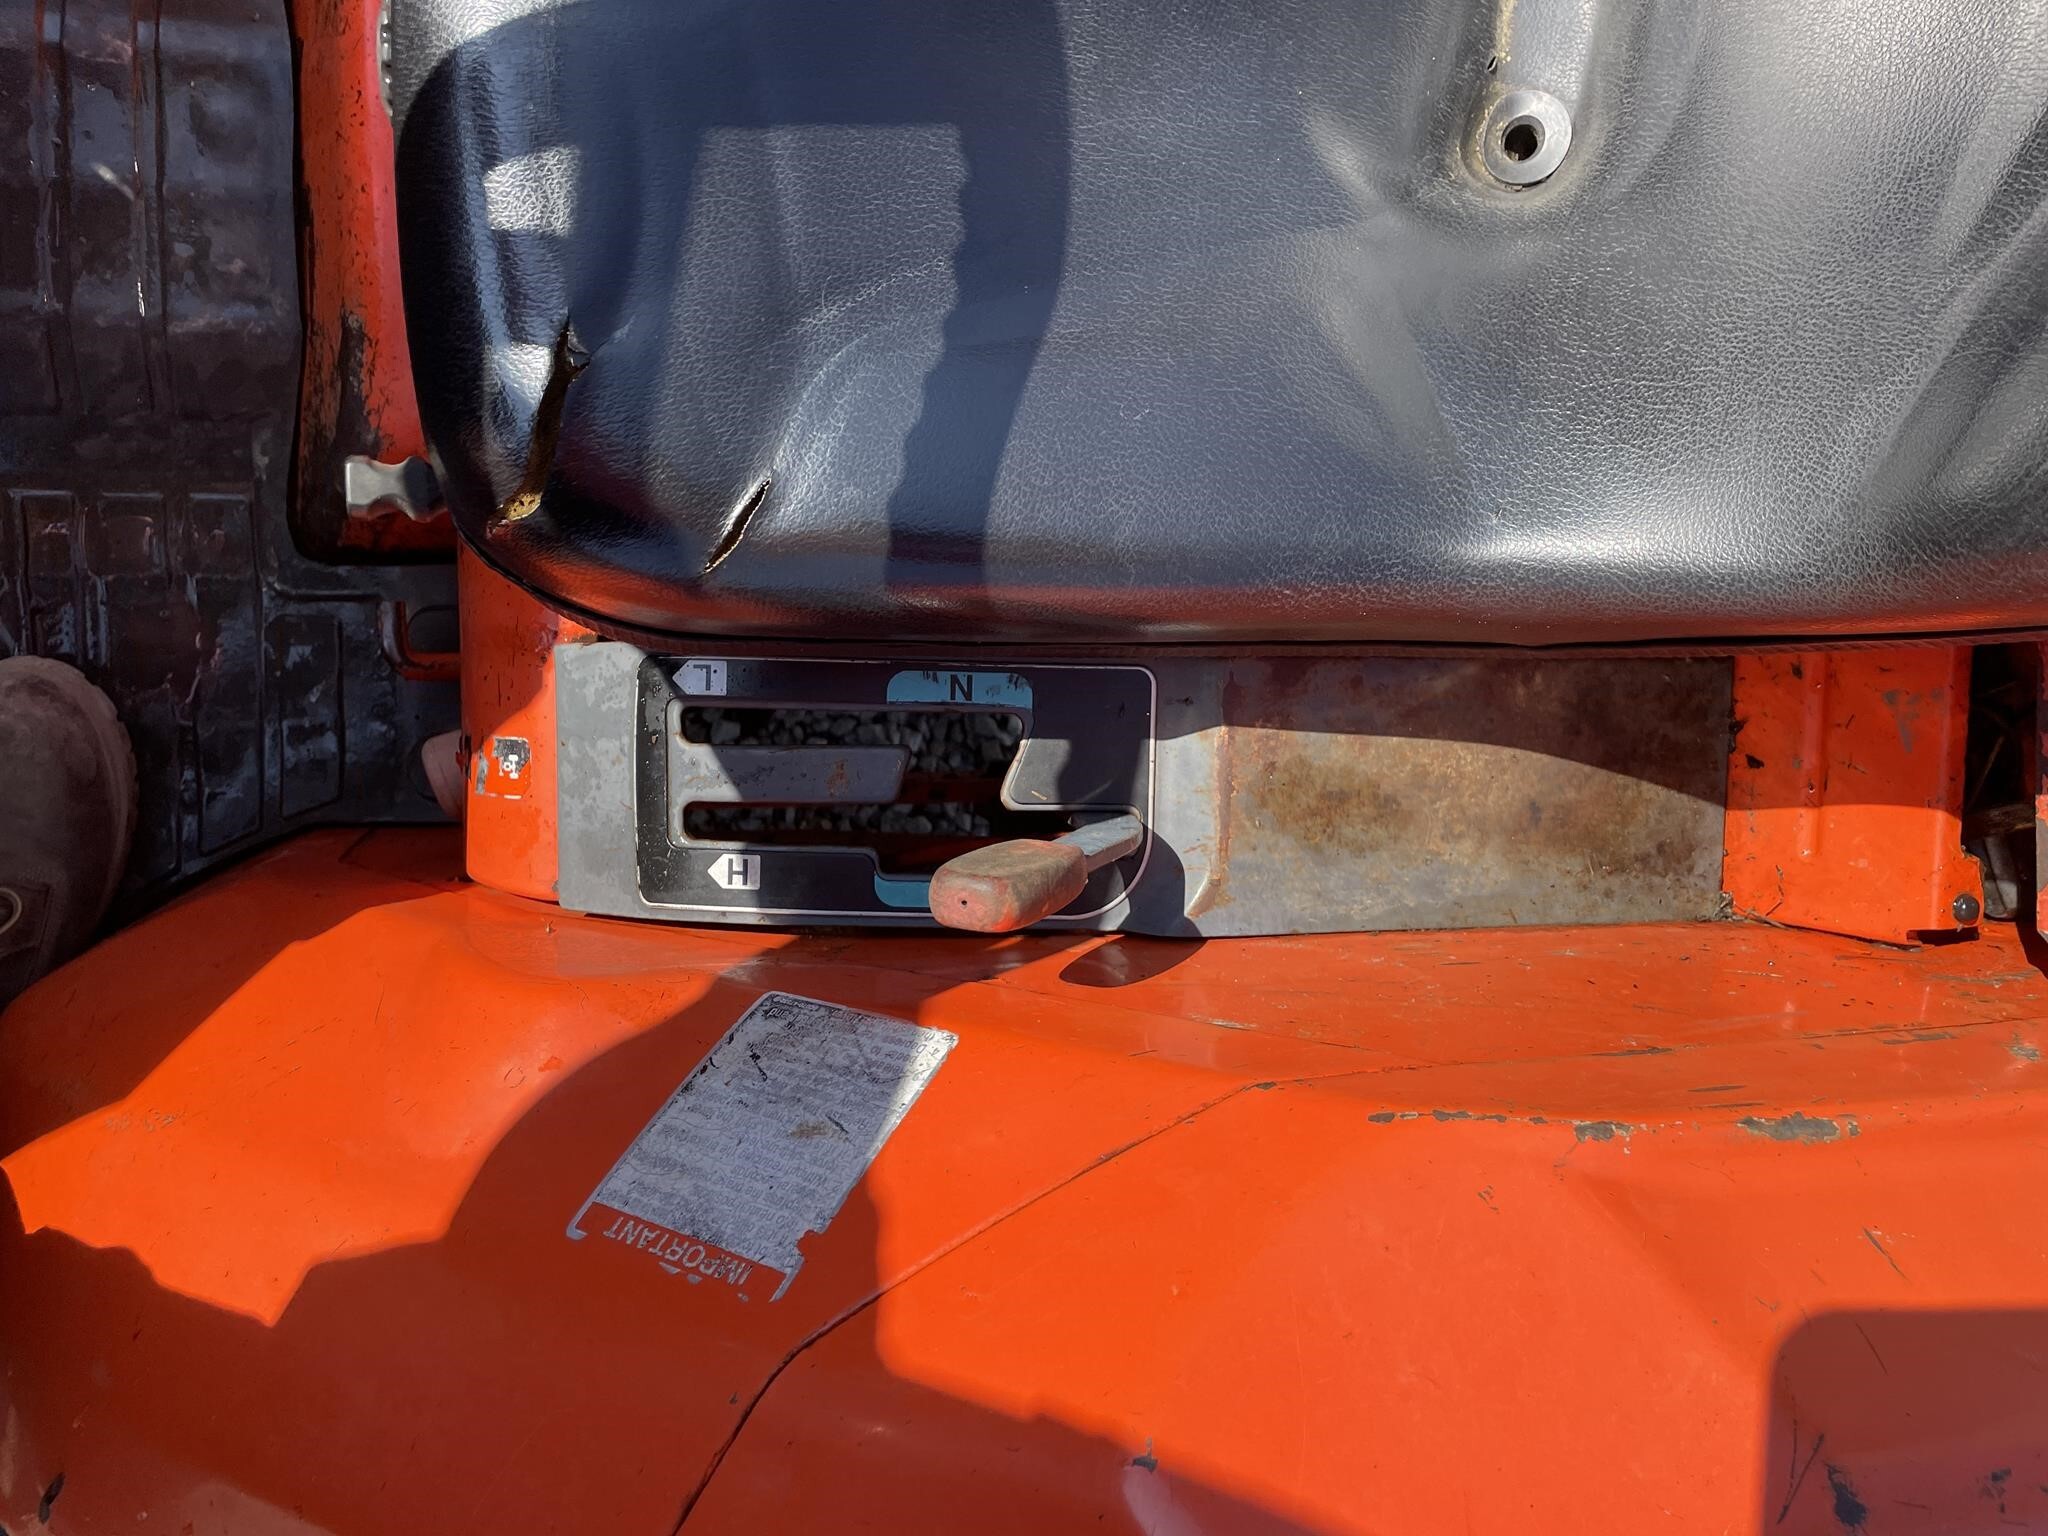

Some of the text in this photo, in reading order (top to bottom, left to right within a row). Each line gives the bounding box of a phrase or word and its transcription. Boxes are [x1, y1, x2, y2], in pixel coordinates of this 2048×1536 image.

[692, 663, 712, 692] L
[949, 674, 974, 702] N
[727, 858, 749, 886] H
[602, 1216, 753, 1286] IMPORTANT
